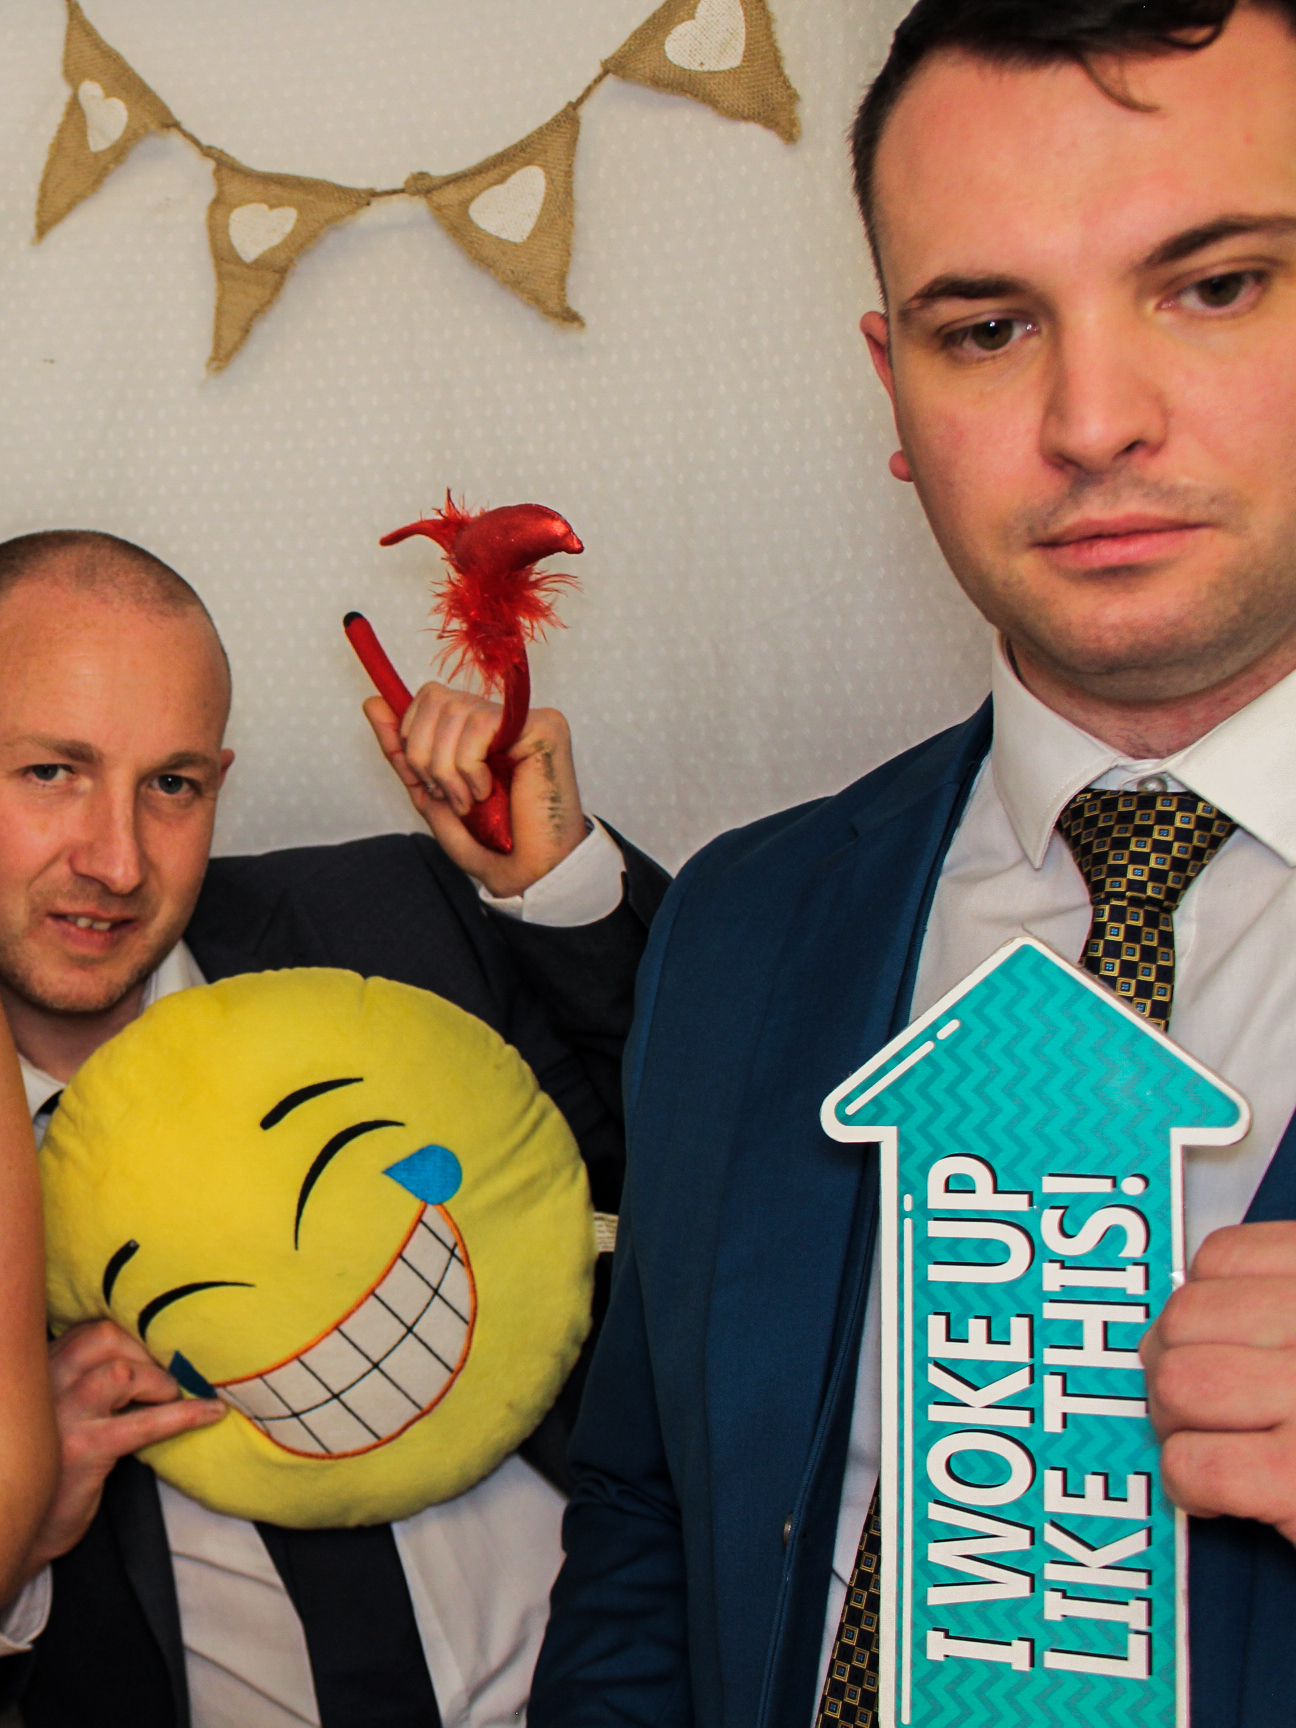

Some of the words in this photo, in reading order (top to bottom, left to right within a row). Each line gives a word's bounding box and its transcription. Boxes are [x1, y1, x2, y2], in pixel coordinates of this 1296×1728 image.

[927, 1152, 1035, 1284] UP
[1042, 1173, 1151, 1433] THIS!
[926, 1312, 1036, 1606] WOKE
[927, 1627, 1035, 1672] I
[1044, 1467, 1152, 1680] LIKE
